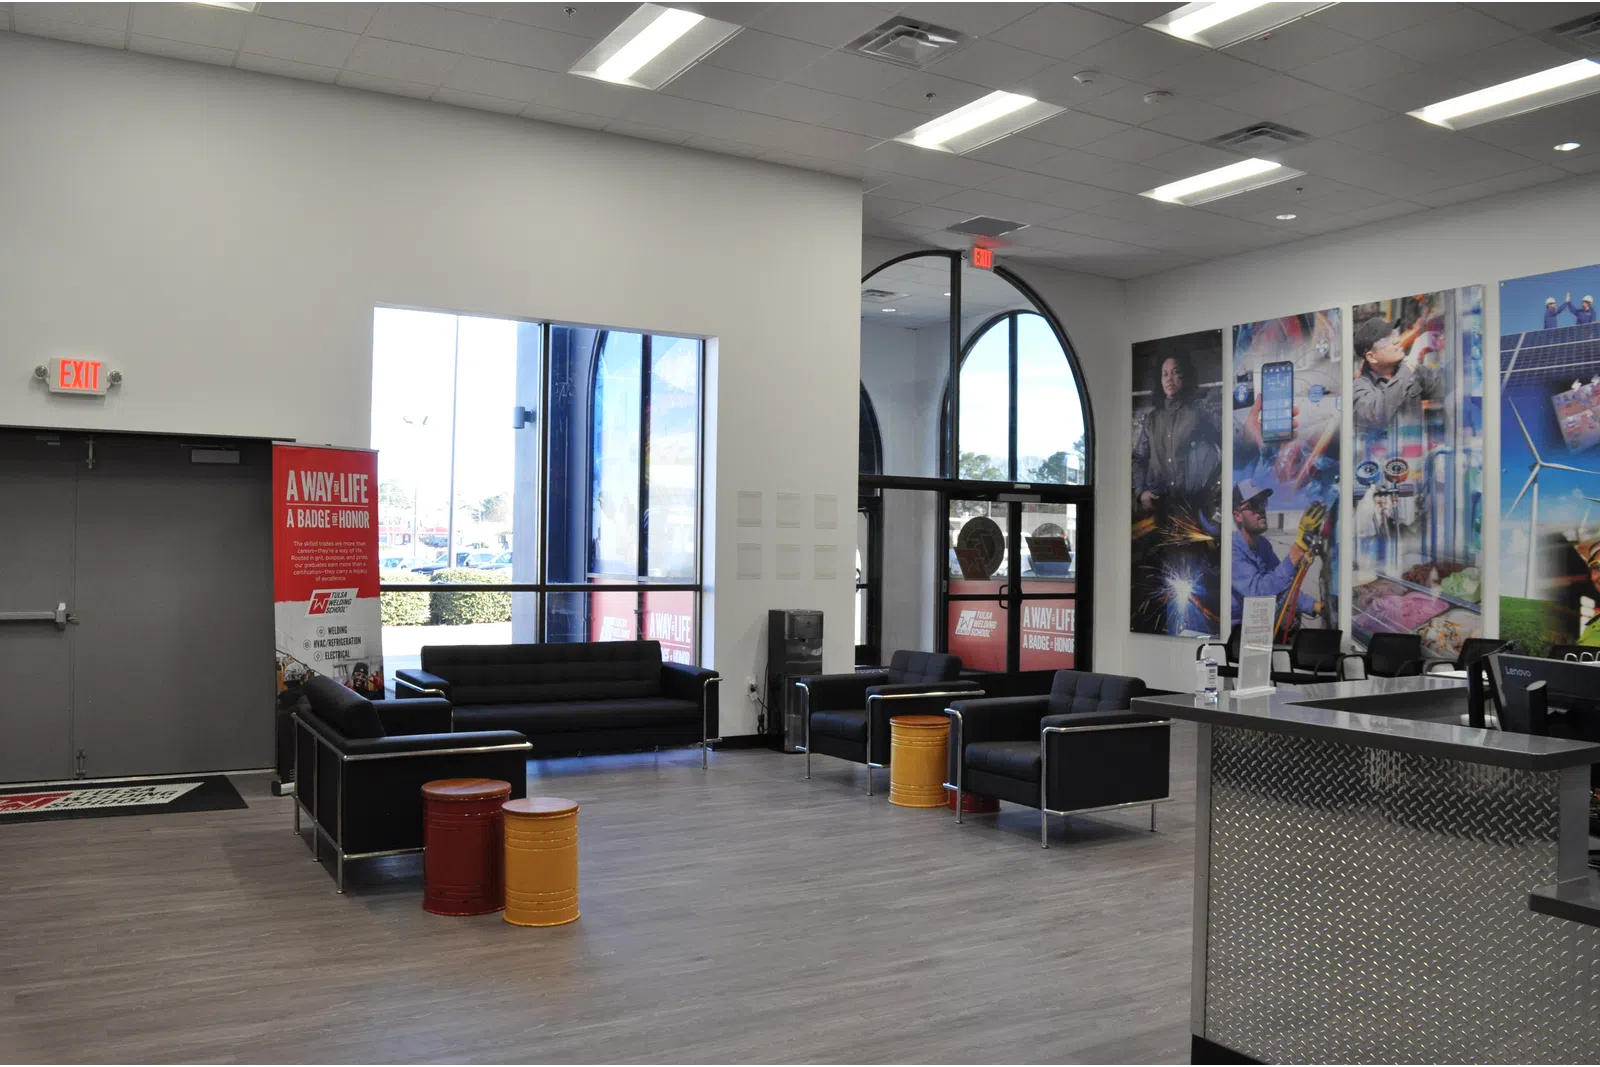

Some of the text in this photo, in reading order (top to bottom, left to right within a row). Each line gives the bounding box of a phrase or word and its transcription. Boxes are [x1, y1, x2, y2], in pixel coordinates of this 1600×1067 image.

[974, 247, 993, 268] EXIT
[59, 359, 101, 390] EXIT
[286, 470, 299, 501] A
[300, 470, 334, 502] WAY
[340, 473, 369, 503] LIFE
[286, 509, 295, 528] A
[297, 509, 331, 528] BADGE
[339, 510, 370, 529] HONOR
[1023, 606, 1030, 628] A
[1031, 606, 1052, 629] WAY
[327, 626, 348, 635] WELDING
[675, 614, 691, 643] LIFE
[313, 637, 362, 648] HVAC/REFRIGERATION
[1022, 634, 1028, 649] A
[1028, 635, 1050, 651] BADGE
[324, 650, 351, 660] ELECTRICAL
[1504, 665, 1532, 678] Lenovo
